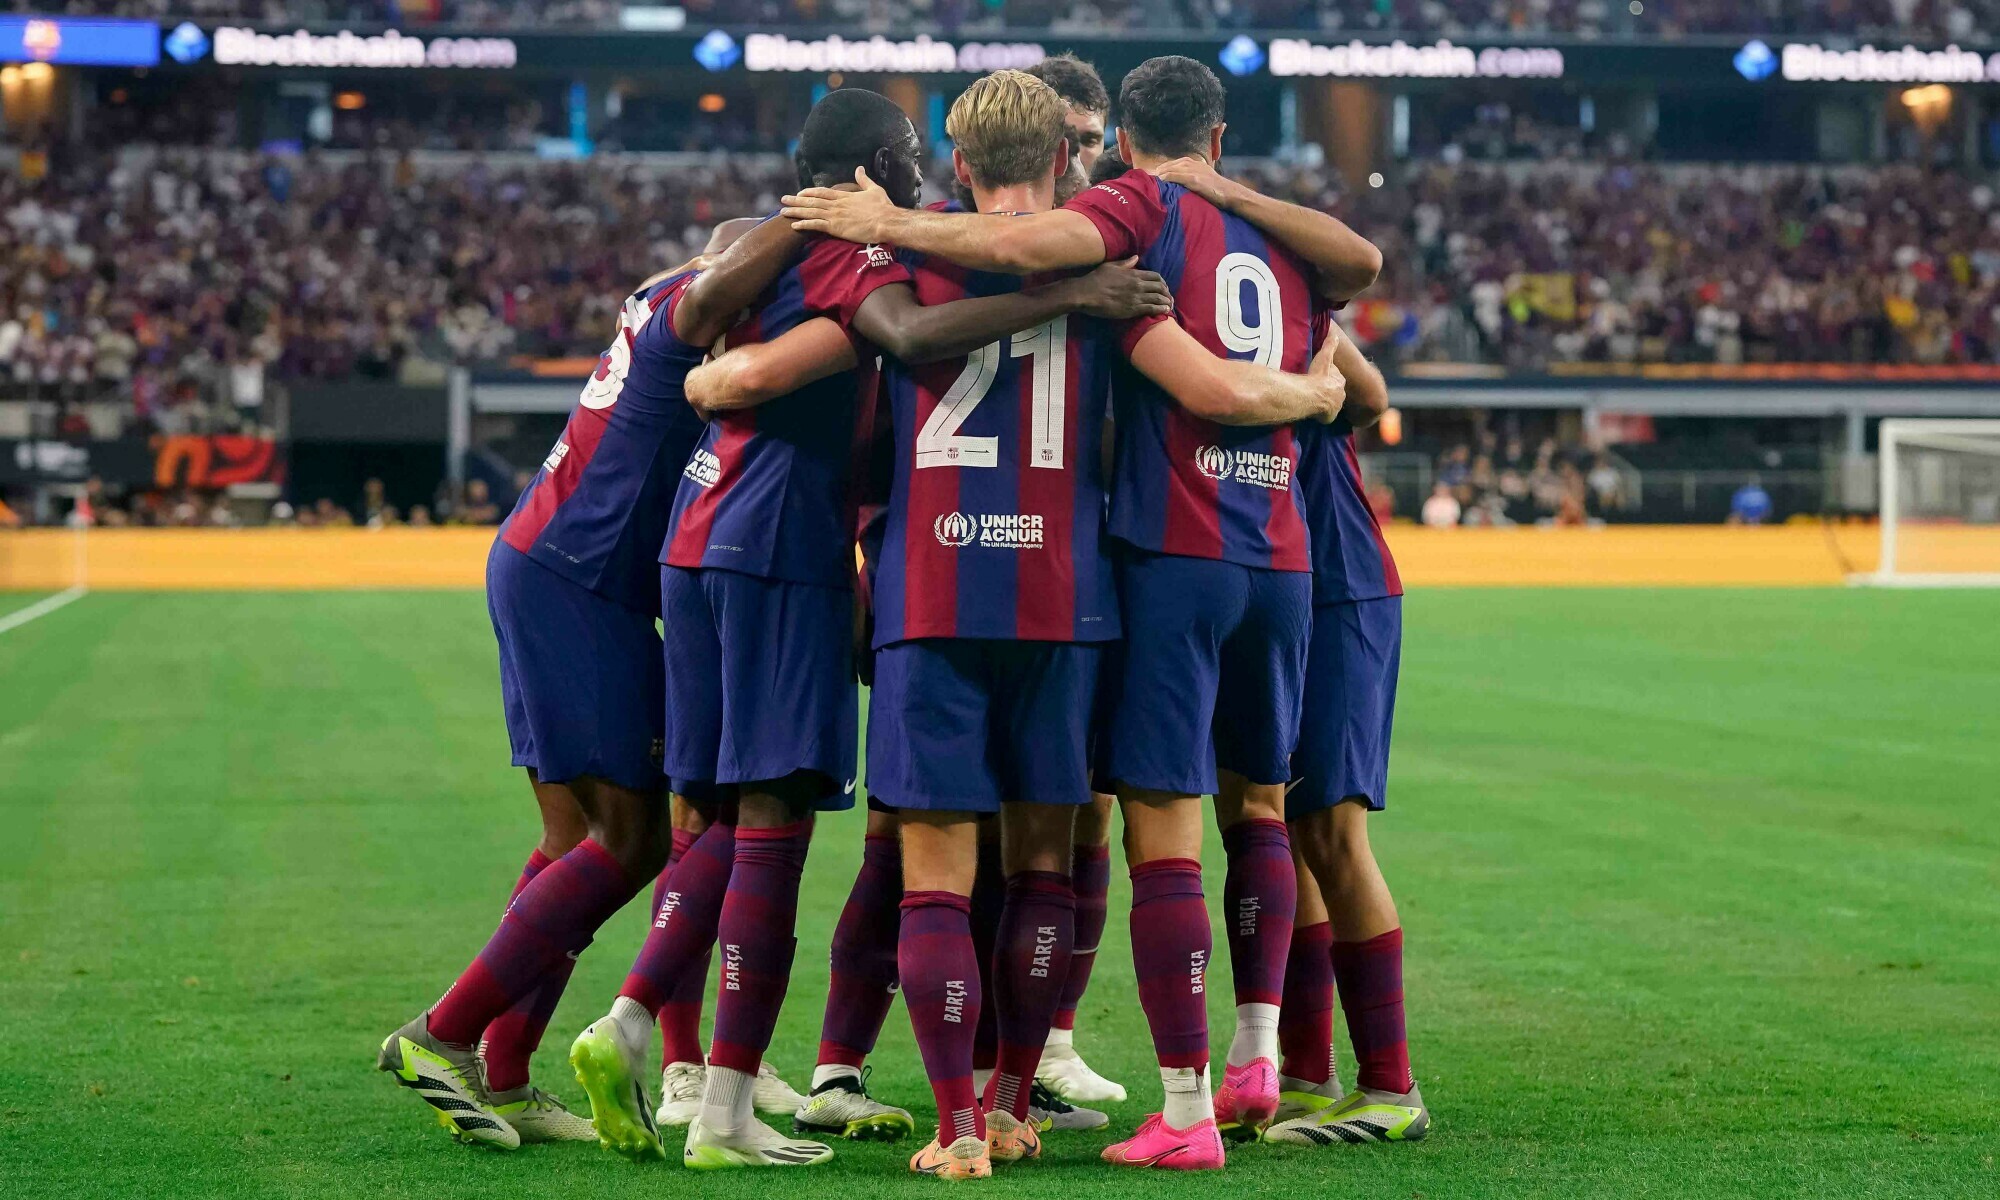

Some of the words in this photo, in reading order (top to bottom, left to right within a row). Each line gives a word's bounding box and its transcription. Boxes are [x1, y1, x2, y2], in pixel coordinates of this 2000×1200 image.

[1215, 252, 1284, 372] 9
[916, 314, 1068, 470] 21
[1235, 465, 1289, 485] ACNUR
[1236, 451, 1290, 471] UNHCR
[980, 528, 1043, 542] ACNUR
[981, 514, 1043, 528] UNHCR
[654, 891, 682, 929] BARÇA
[1240, 896, 1262, 937] BARÇA
[725, 943, 744, 991] BARÇA
[1029, 925, 1057, 979] BARÇA
[1190, 949, 1205, 995] BARÇA
[943, 979, 968, 1024] BARÇA
